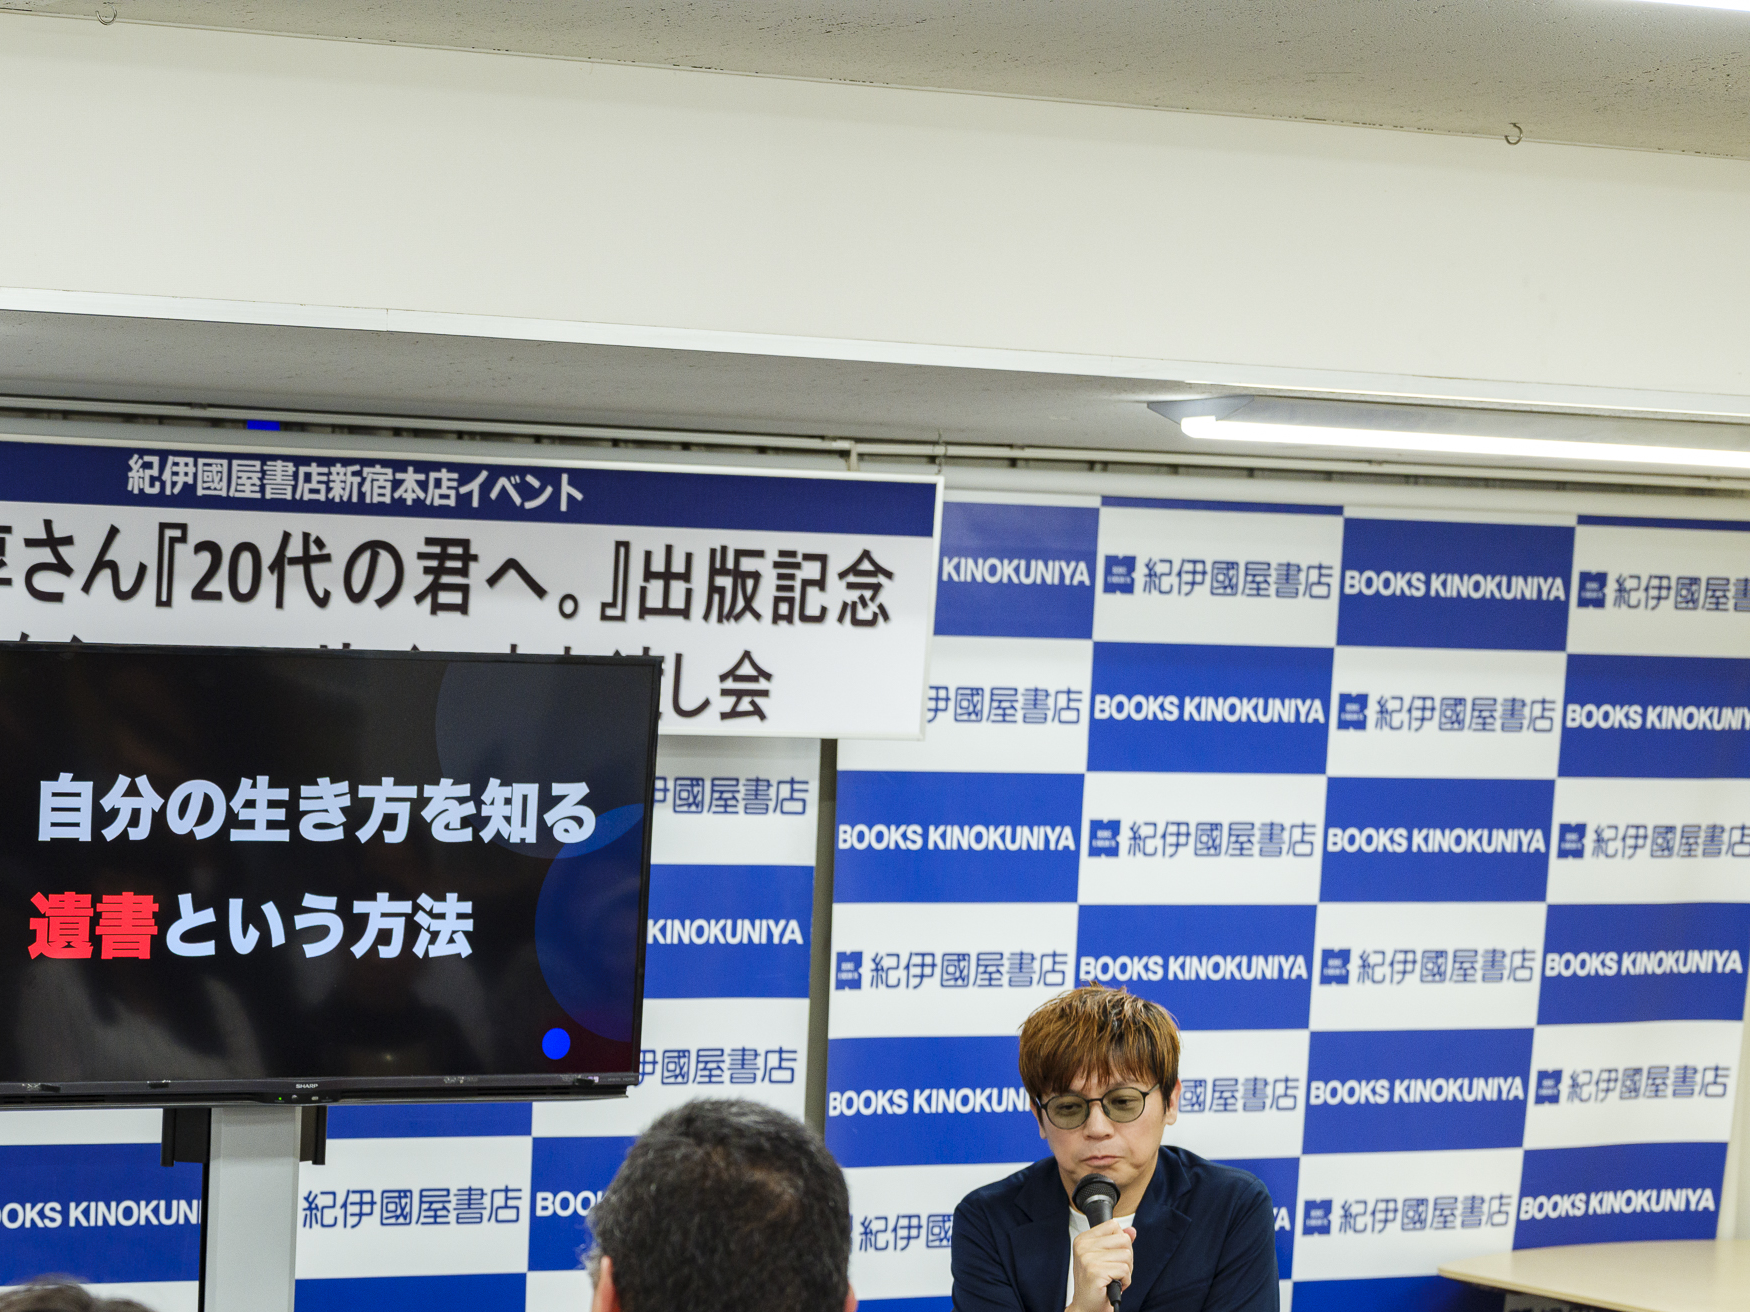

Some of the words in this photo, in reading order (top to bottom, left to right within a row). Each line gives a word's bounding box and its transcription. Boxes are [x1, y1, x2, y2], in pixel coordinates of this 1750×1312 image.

[127, 454, 583, 512] 紀伊國屋書店新宿本店イベント
[942, 557, 1090, 585] KINOKUNIYA
[1143, 558, 1333, 599] 紀伊國屋書店
[1344, 570, 1425, 597] BOOKS
[1431, 573, 1565, 601] KINOKUNIYA
[1094, 694, 1179, 721] BOOKS
[1184, 696, 1325, 723] KINOKUNIYA
[1375, 696, 1556, 733] 紀伊國屋書店
[1566, 704, 1642, 729] BOOKS
[37, 772, 597, 845] 自分の生き方を知る
[838, 824, 923, 850] BOOKS
[928, 825, 1075, 851] KINOKUNIYA
[1128, 822, 1316, 858] 紀伊國屋書店
[1327, 827, 1407, 853] BOOKS
[1412, 828, 1545, 853] KINOKUNIYA
[27, 891, 474, 960] 遺書という方法
[647, 919, 803, 944] KINOKUNIYA
[871, 951, 1067, 989] 紀伊國屋書店
[1079, 956, 1162, 981] BOOKS
[1168, 955, 1307, 980] KINOKUNIYA
[1357, 948, 1535, 984] 紀伊國屋書店
[1545, 952, 1618, 977] BOOKS
[1622, 950, 1742, 975] KINOKUNIYA
[1310, 1079, 1389, 1105] BOOKS
[1394, 1077, 1524, 1103] KINOKUNIYA
[1567, 1065, 1729, 1102] 紀伊國屋書店
[829, 1089, 908, 1116] BOOKS
[303, 1185, 522, 1228] 紀伊國屋書店
[536, 1190, 600, 1217] BOO
[1339, 1194, 1511, 1234] 紀伊國屋書店
[1520, 1194, 1585, 1220] BOOKS
[1588, 1188, 1715, 1215] KINOKUNIYA
